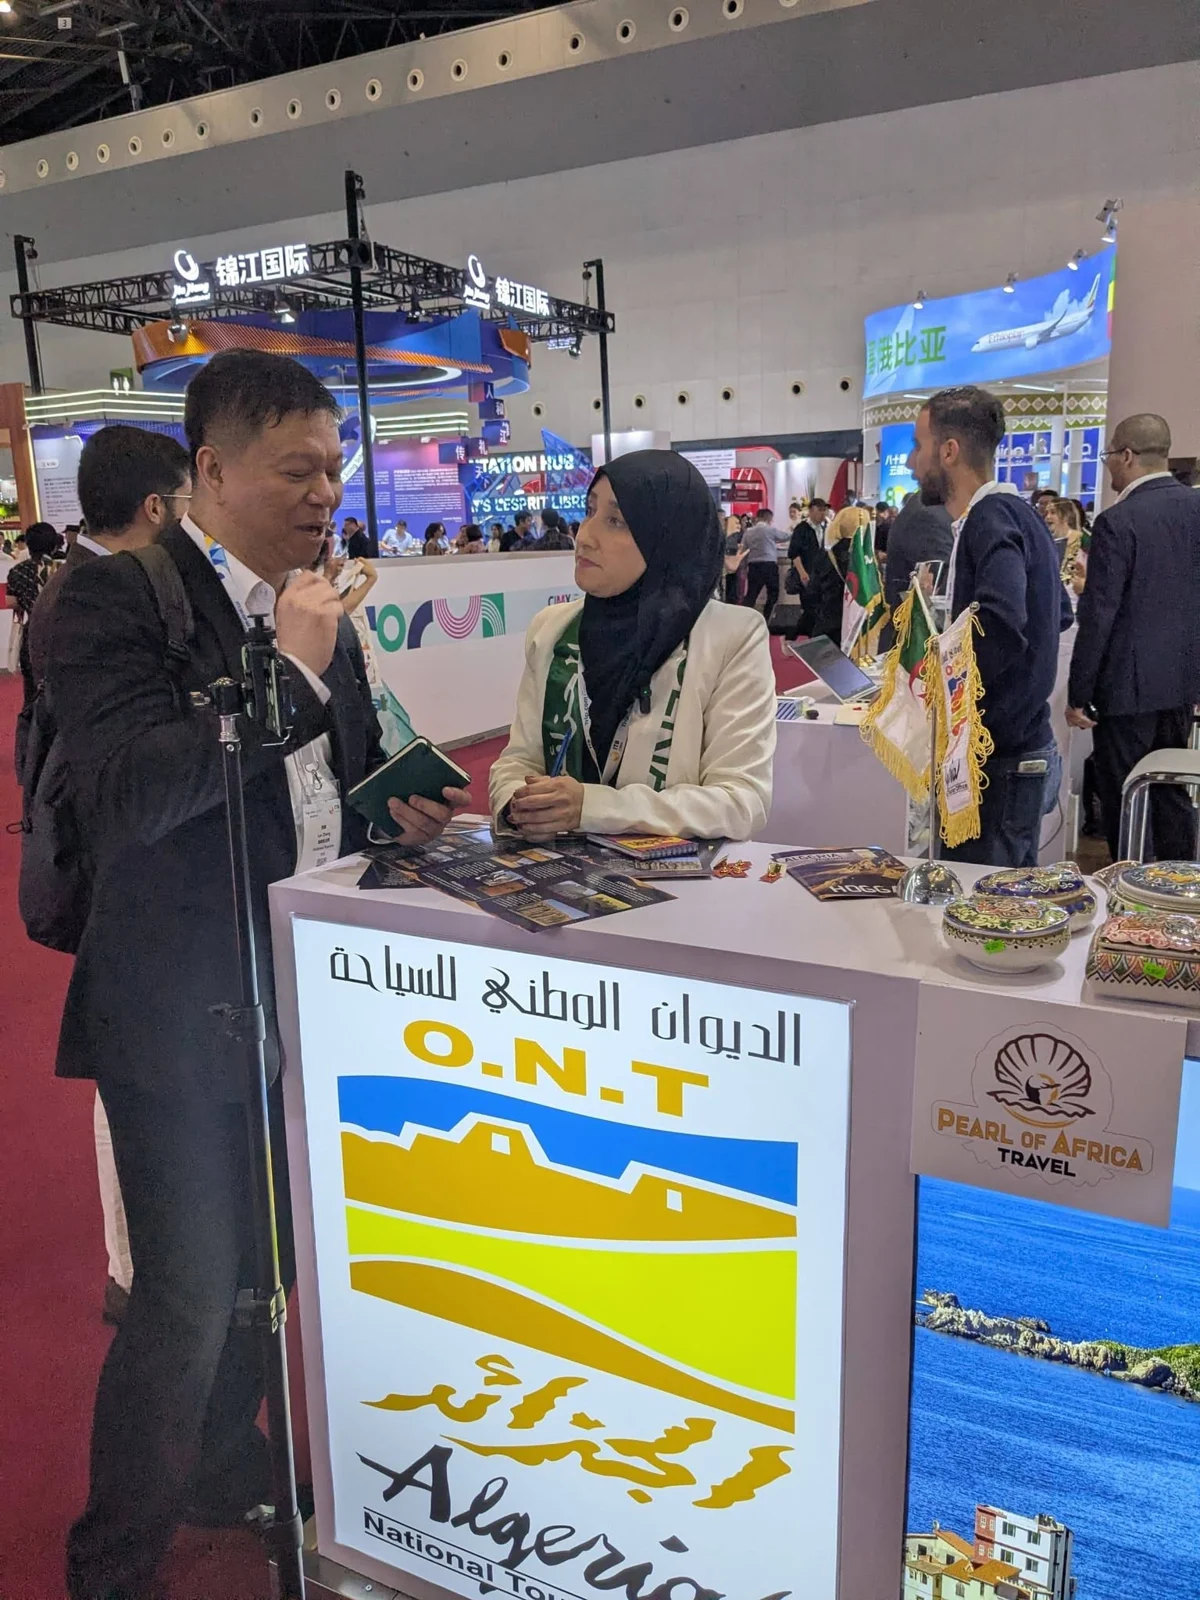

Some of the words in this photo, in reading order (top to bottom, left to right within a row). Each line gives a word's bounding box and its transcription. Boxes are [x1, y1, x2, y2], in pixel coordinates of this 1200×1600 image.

[215, 244, 309, 286] 锦江国际
[495, 276, 550, 316] 锦江国际
[469, 455, 537, 474] TATION
[540, 454, 575, 471] HUB
[329, 944, 457, 1002] للسياحة
[481, 966, 621, 1032] الوطني
[651, 992, 802, 1067] الديوان
[937, 1107, 1014, 1146] PEARL
[1052, 1129, 1144, 1171] AFRICA
[997, 1147, 1076, 1178] TRAVEL
[363, 1511, 494, 1583] National
